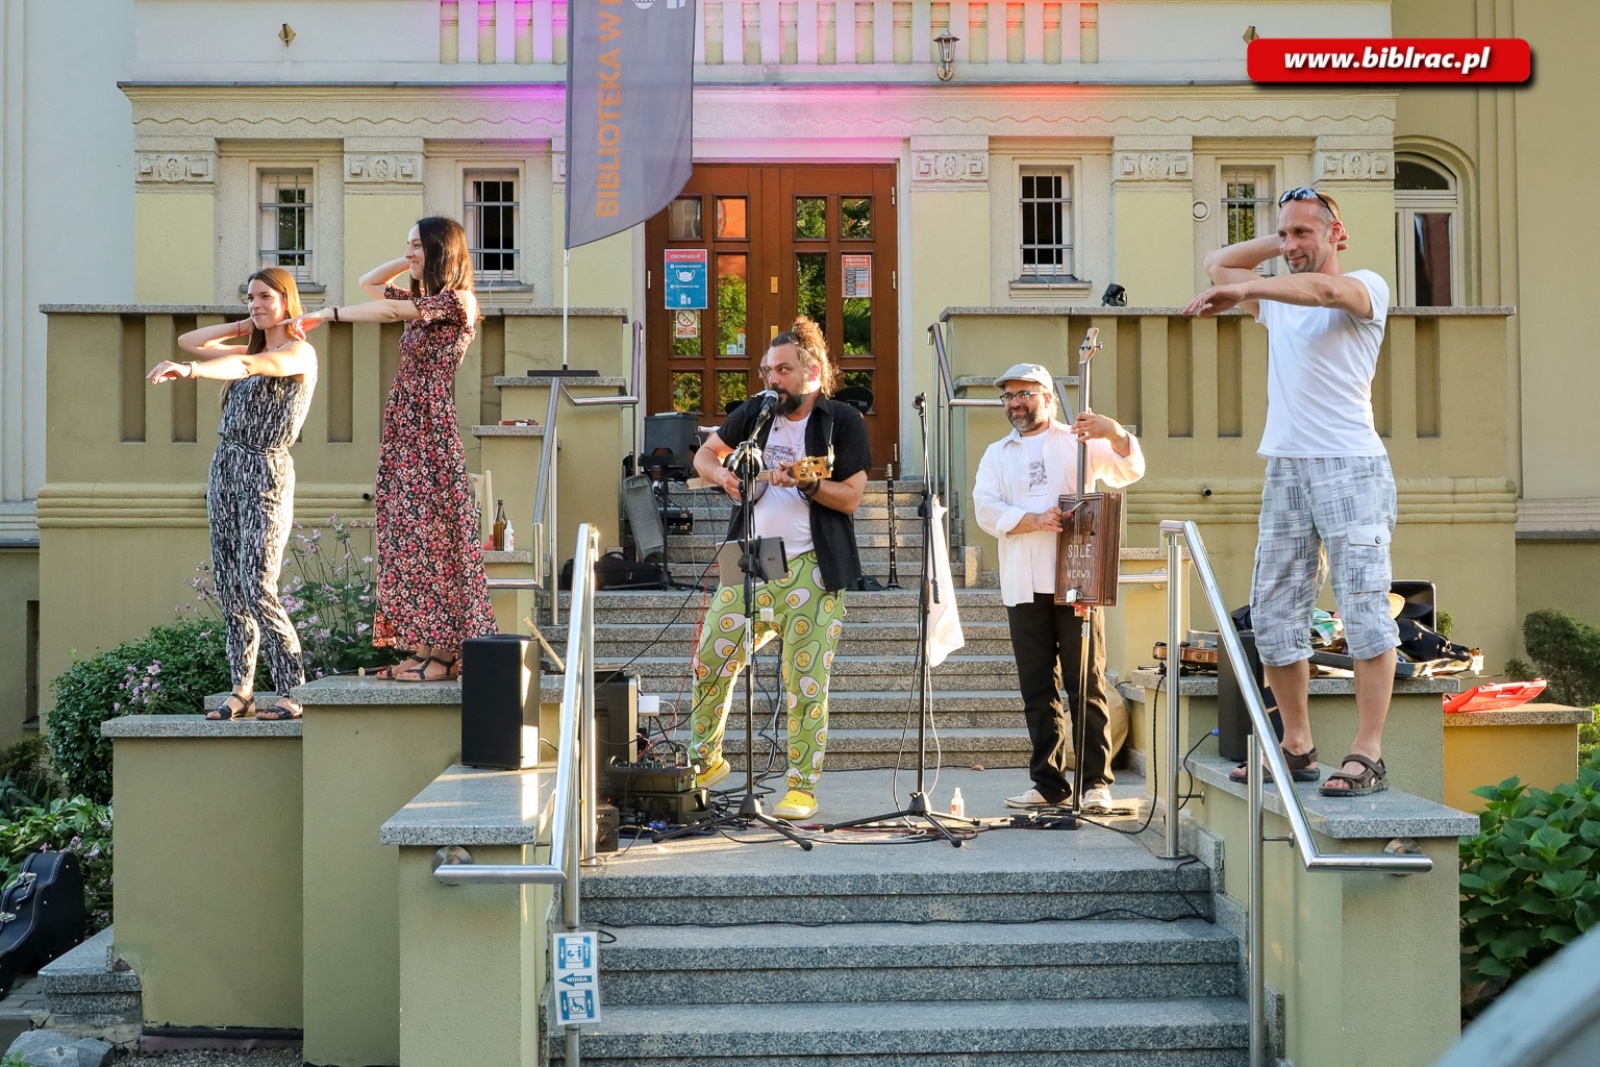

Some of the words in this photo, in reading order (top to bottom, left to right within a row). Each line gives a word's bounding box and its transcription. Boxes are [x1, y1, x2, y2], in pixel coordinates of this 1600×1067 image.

[598, 11, 623, 43] W
[596, 47, 623, 218] BIBLIOTEKA
[1067, 543, 1092, 559] SOLE
